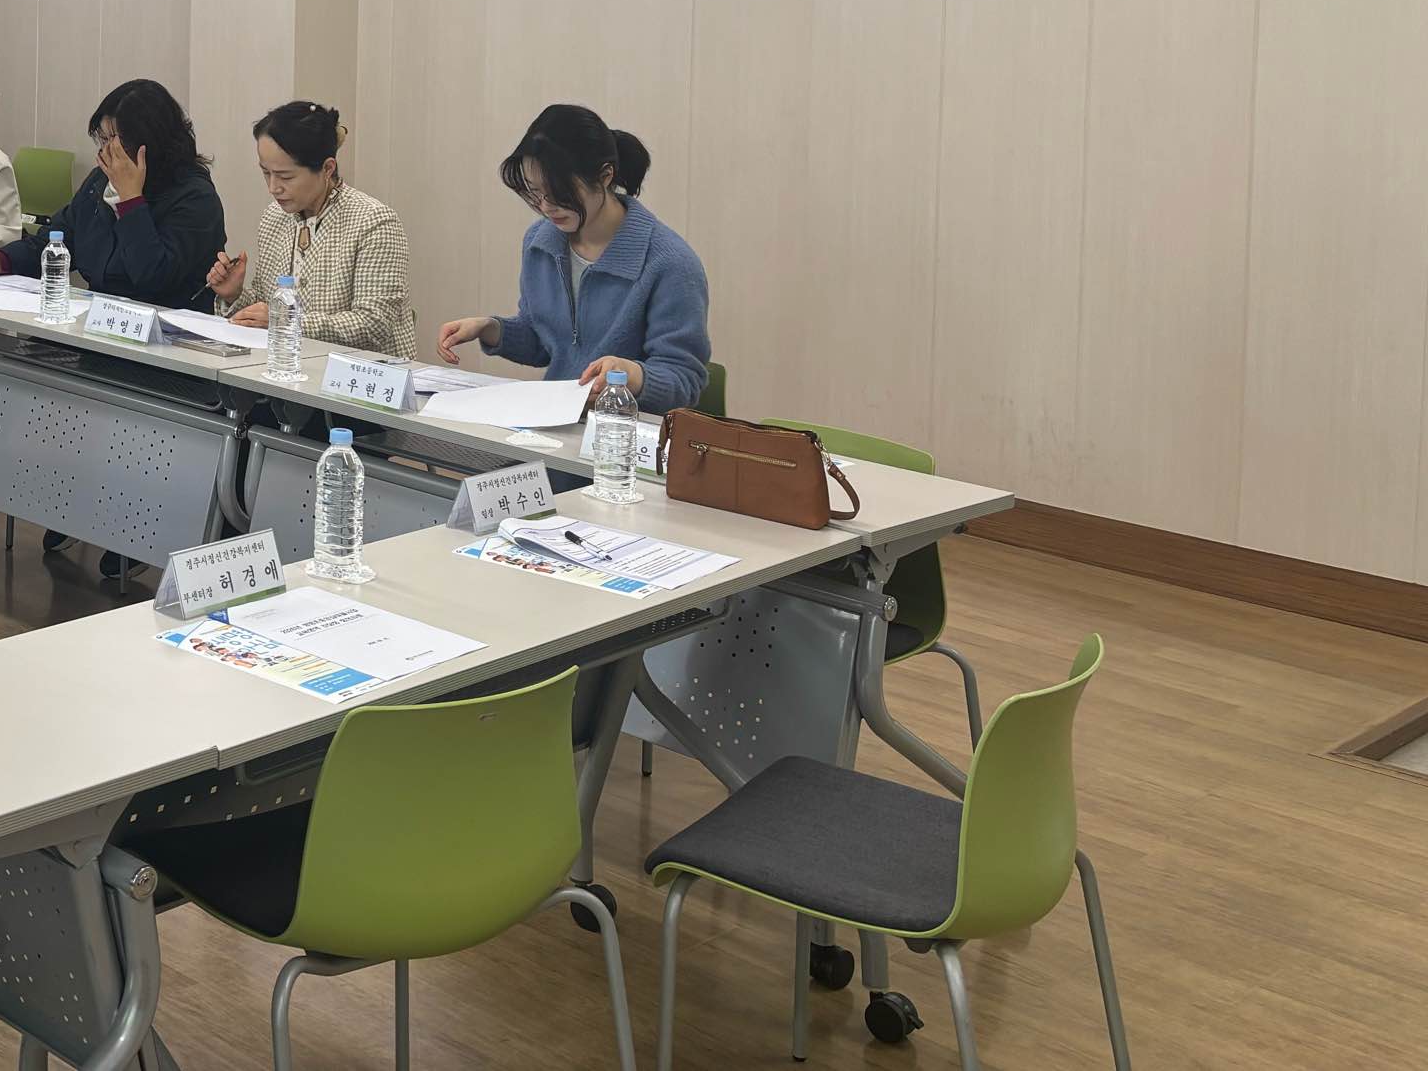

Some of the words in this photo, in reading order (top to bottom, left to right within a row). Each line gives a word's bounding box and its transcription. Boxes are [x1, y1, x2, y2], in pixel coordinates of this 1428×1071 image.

[477, 469, 539, 492] 경주시정신건강복지센터
[186, 540, 265, 570] 경주시정신건강복지센터
[183, 587, 213, 604] 부센터장
